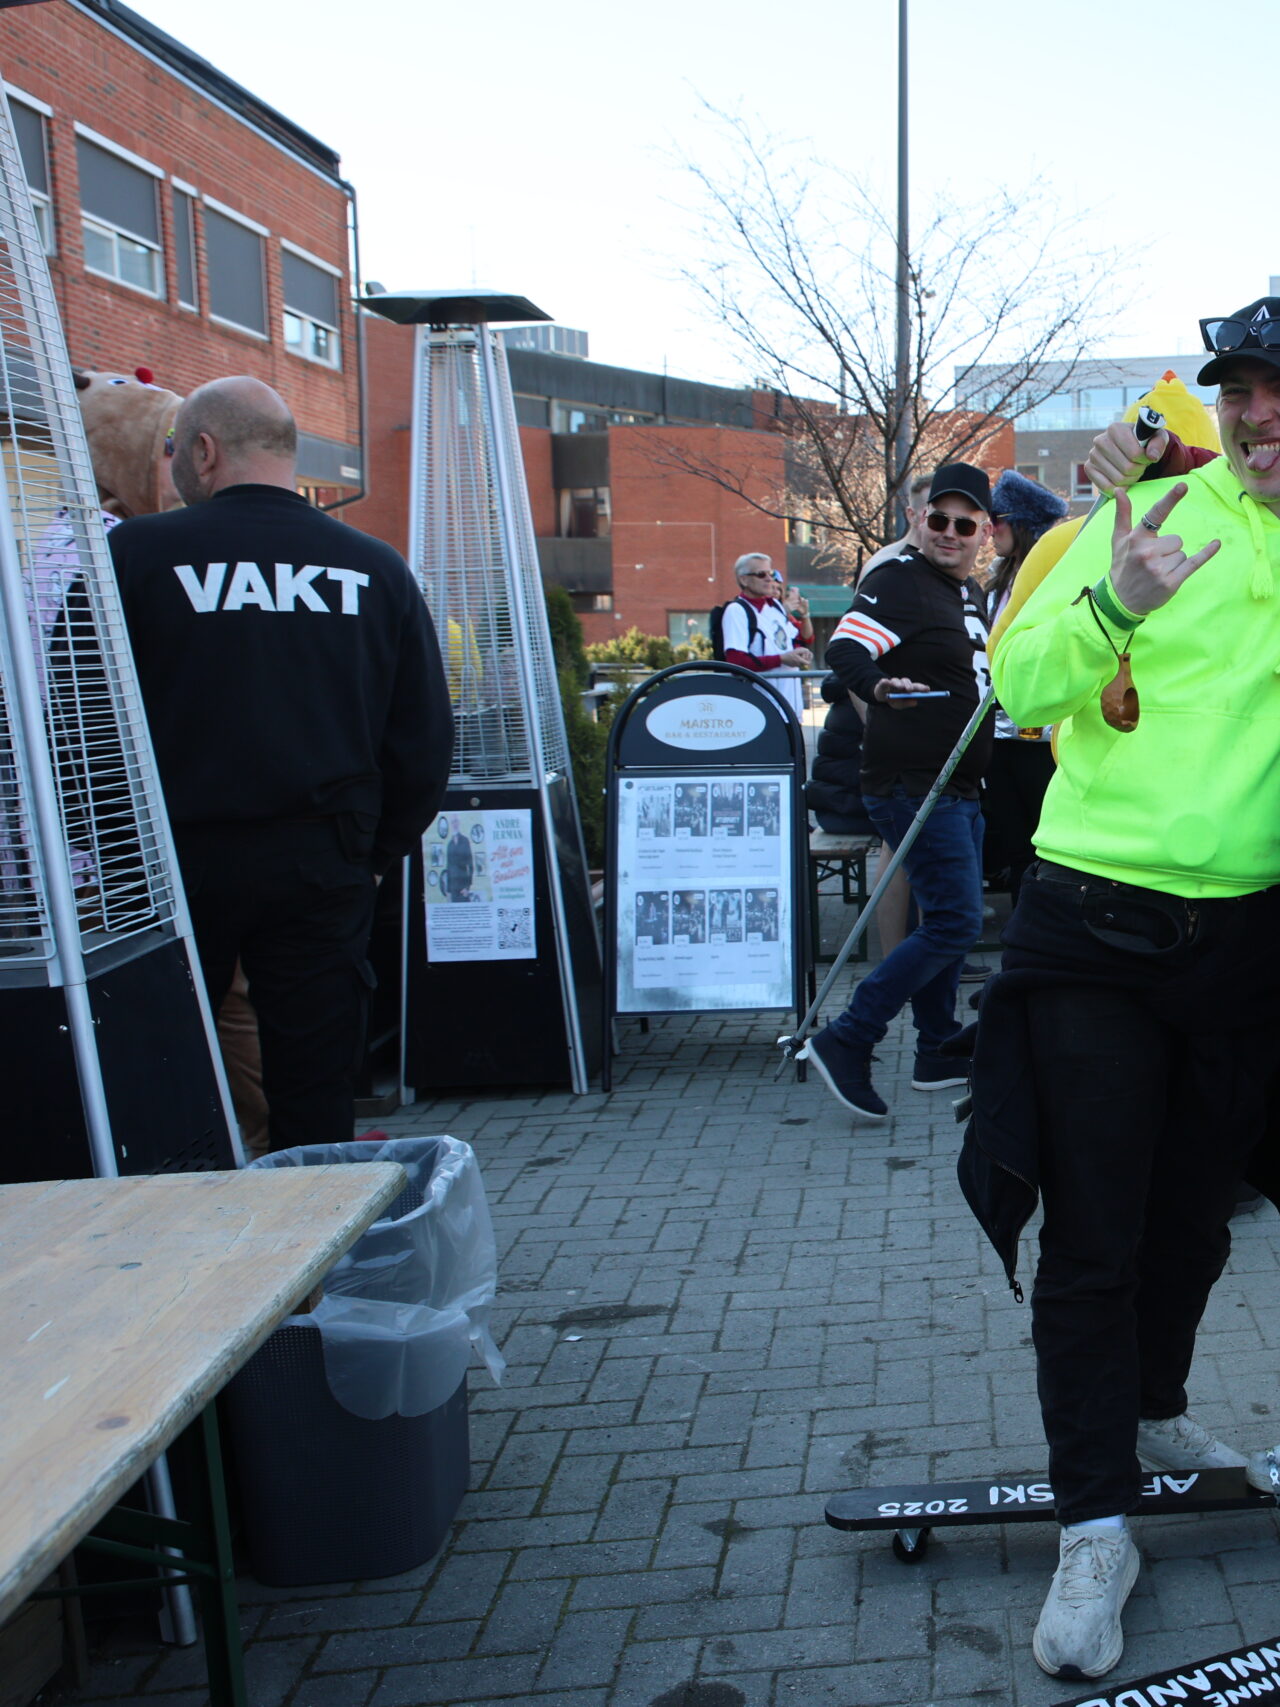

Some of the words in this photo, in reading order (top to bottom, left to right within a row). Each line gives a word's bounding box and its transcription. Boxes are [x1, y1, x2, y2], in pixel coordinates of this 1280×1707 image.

[173, 562, 370, 615] VAKT
[680, 719, 734, 730] MAISTRO
[877, 1498, 968, 1517] 2025
